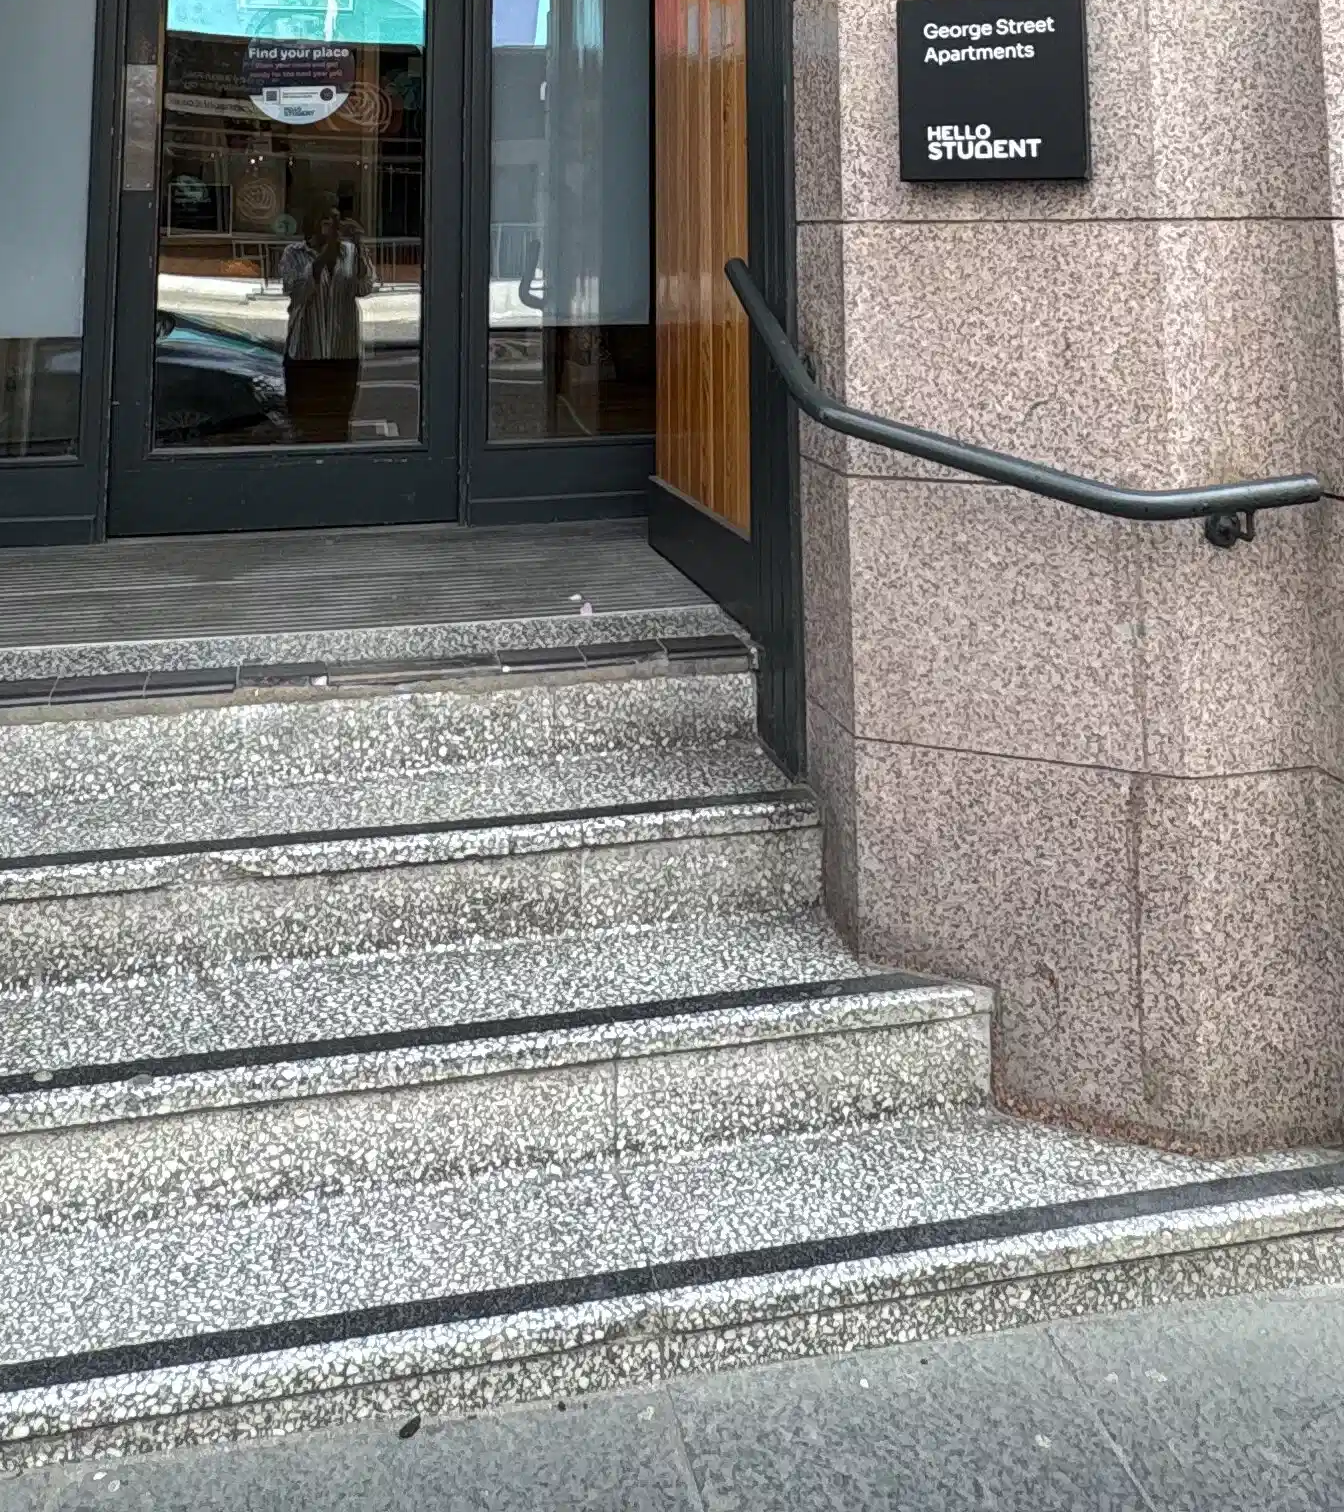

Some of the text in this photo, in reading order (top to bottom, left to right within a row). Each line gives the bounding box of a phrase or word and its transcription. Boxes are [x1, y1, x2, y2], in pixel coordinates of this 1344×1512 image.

[923, 16, 1056, 41] George Street
[248, 47, 350, 61] Find your place
[923, 42, 1035, 66] Apartments
[926, 123, 992, 142] HELLO
[927, 138, 1042, 161] STUDENT
